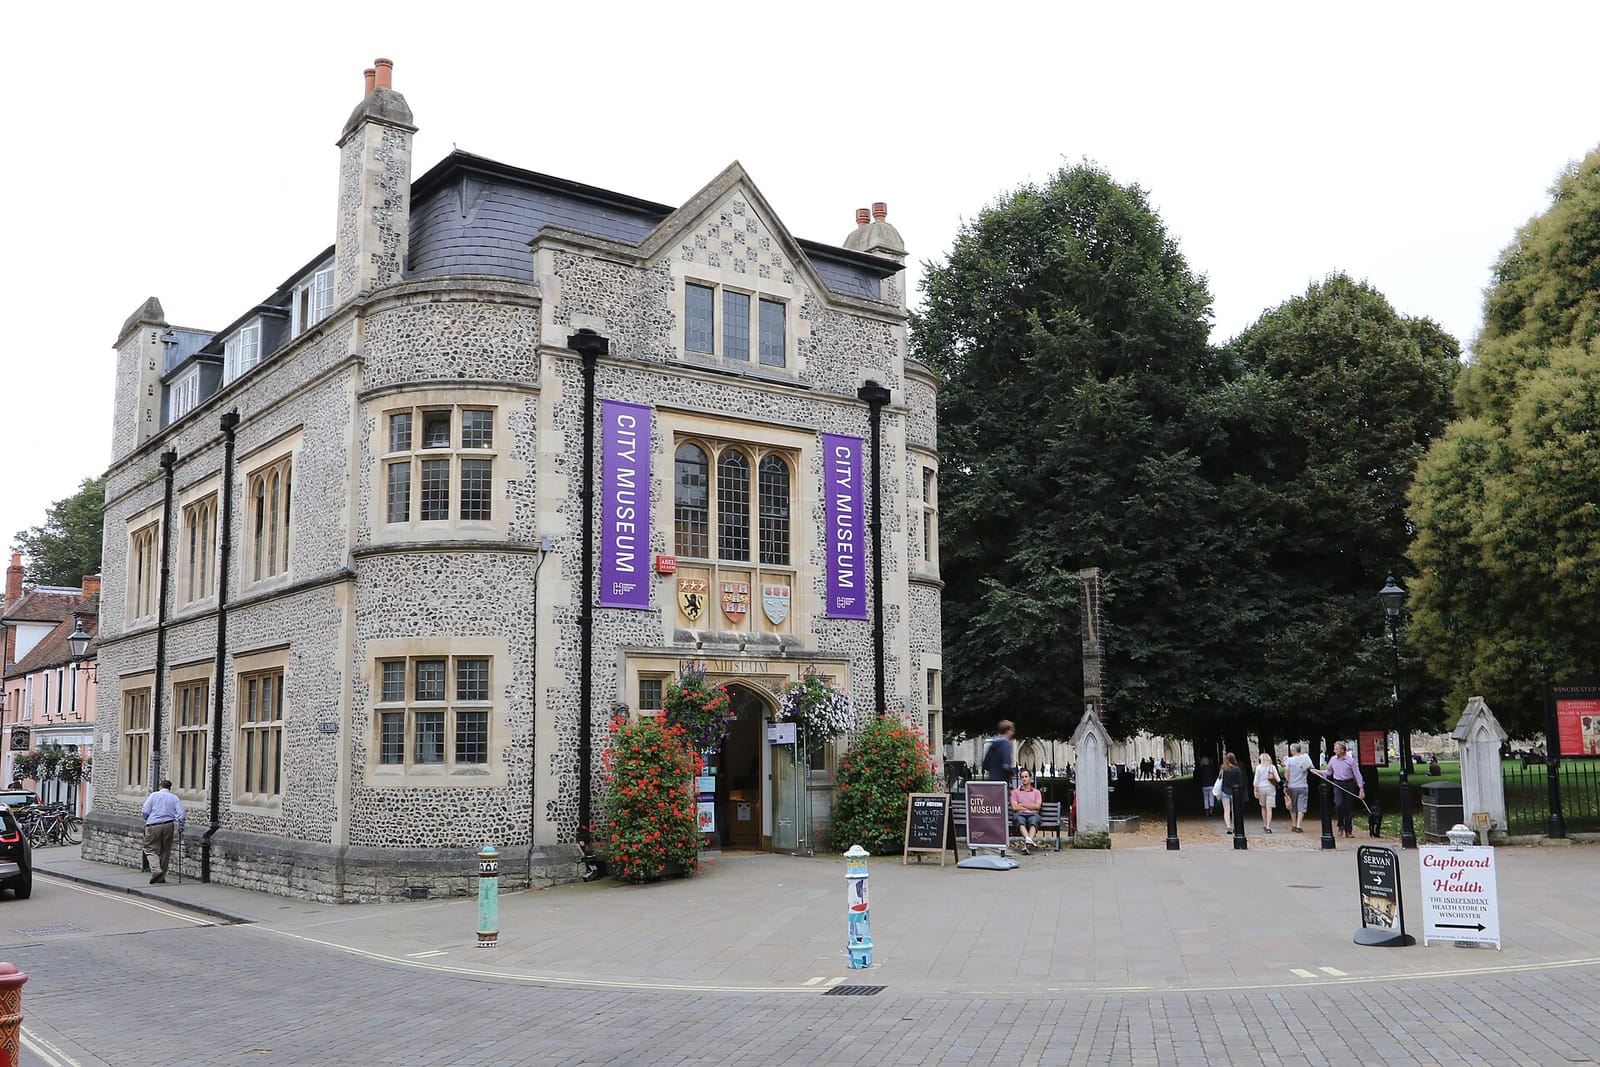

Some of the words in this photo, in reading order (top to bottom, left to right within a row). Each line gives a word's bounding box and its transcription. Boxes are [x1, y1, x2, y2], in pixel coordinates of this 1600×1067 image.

[616, 414, 636, 463] CITY
[835, 446, 852, 490] CITY
[615, 467, 636, 573] MUSEUM
[836, 494, 854, 588] MUSEUM
[970, 806, 1002, 814] MUSEUM
[1363, 855, 1391, 866] SERVAN
[1423, 854, 1491, 871] Cupboard
[1450, 868, 1465, 882] of
[1433, 879, 1484, 893] Health
[1443, 897, 1489, 905] INDEPENDENT
[1439, 911, 1482, 919] WINCHESTER
